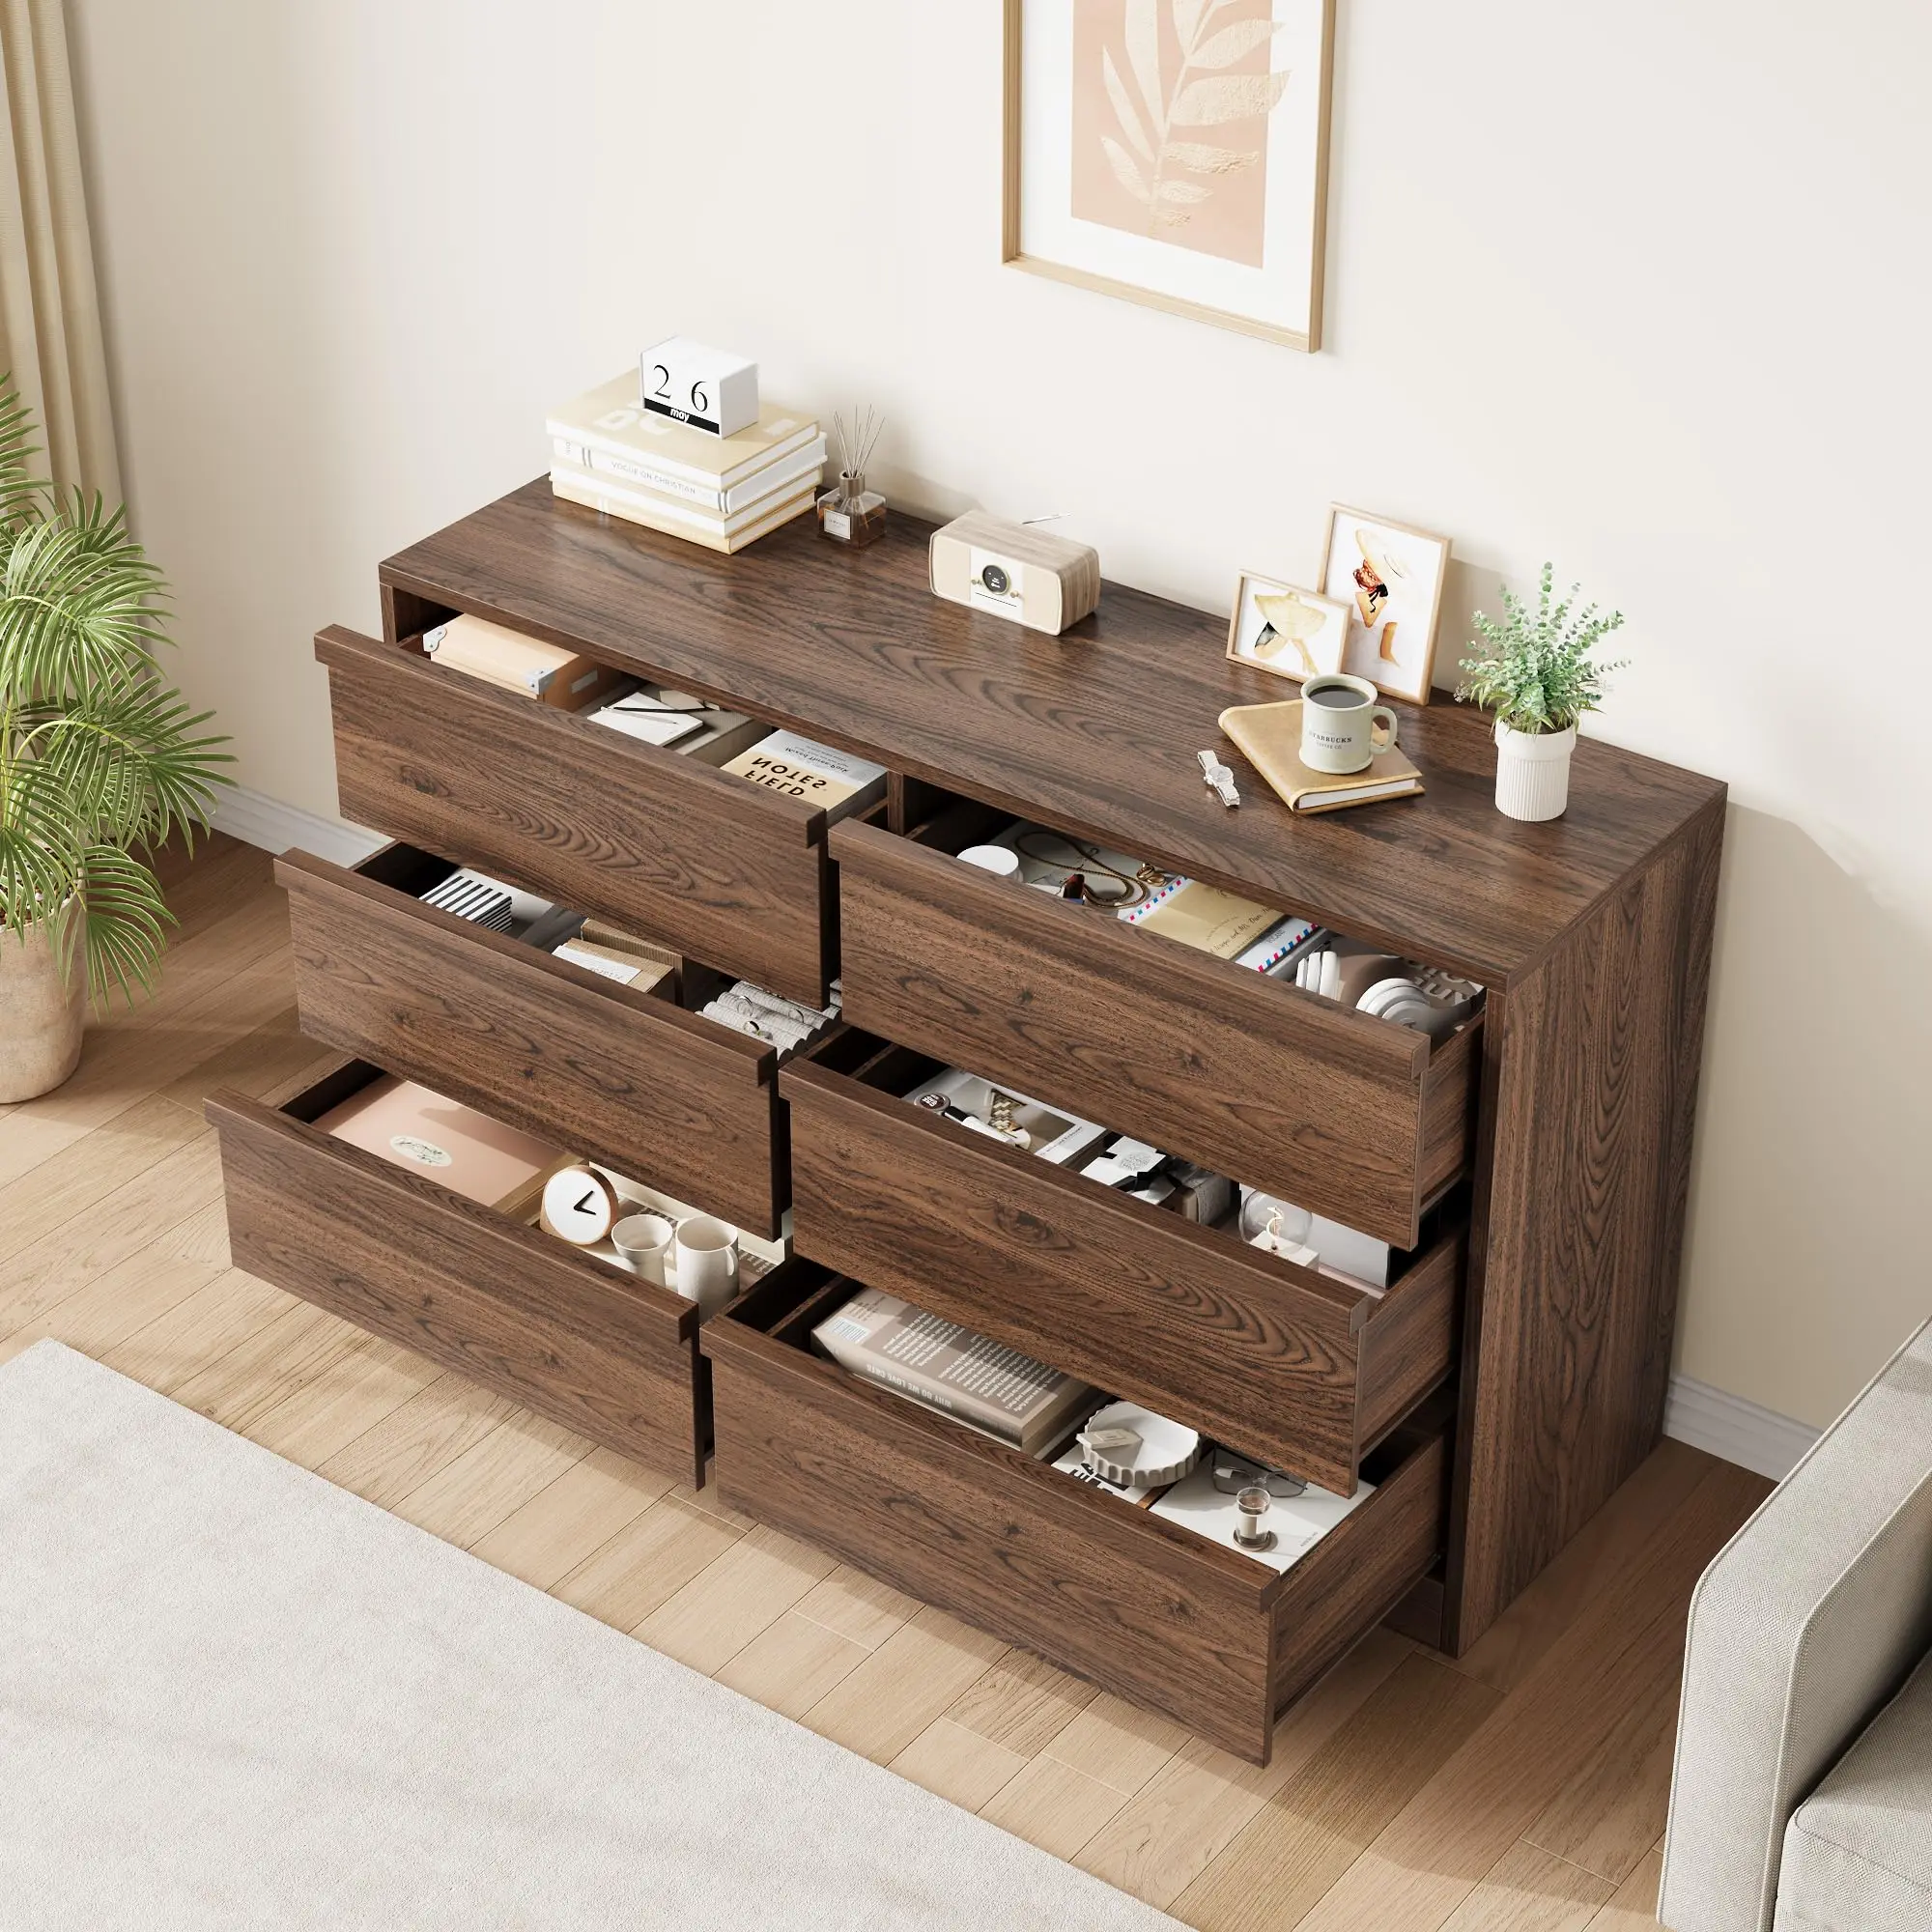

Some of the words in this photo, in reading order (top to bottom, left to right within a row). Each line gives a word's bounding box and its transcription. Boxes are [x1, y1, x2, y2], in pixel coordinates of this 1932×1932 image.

[669, 408, 690, 423] may
[639, 470, 652, 480] ON
[654, 474, 696, 495] CHRISTIAN
